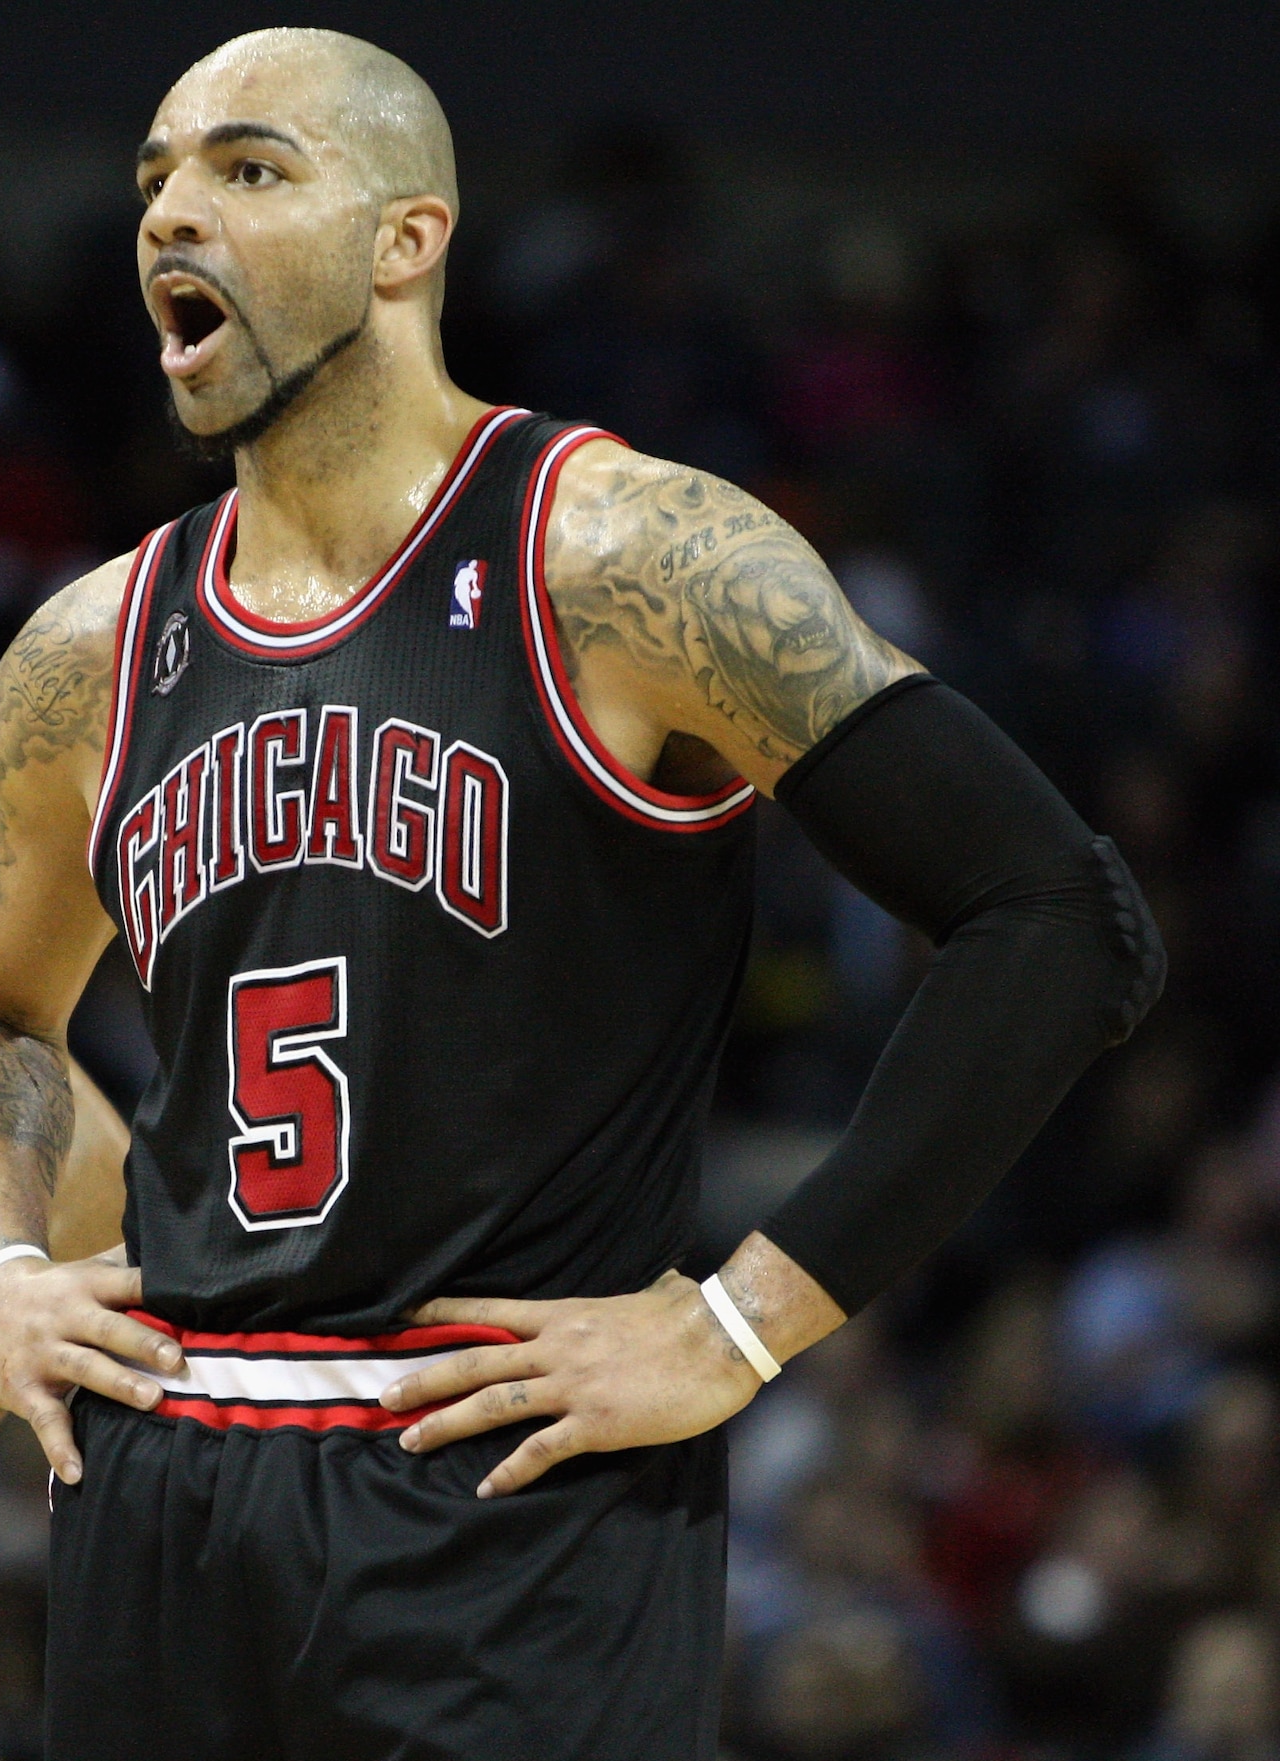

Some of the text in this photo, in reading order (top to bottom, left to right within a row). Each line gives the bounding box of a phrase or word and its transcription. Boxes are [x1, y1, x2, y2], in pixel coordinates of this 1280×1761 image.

[449, 613, 469, 626] NBA
[117, 705, 509, 992] CHICAGO
[227, 956, 351, 1232] 5
